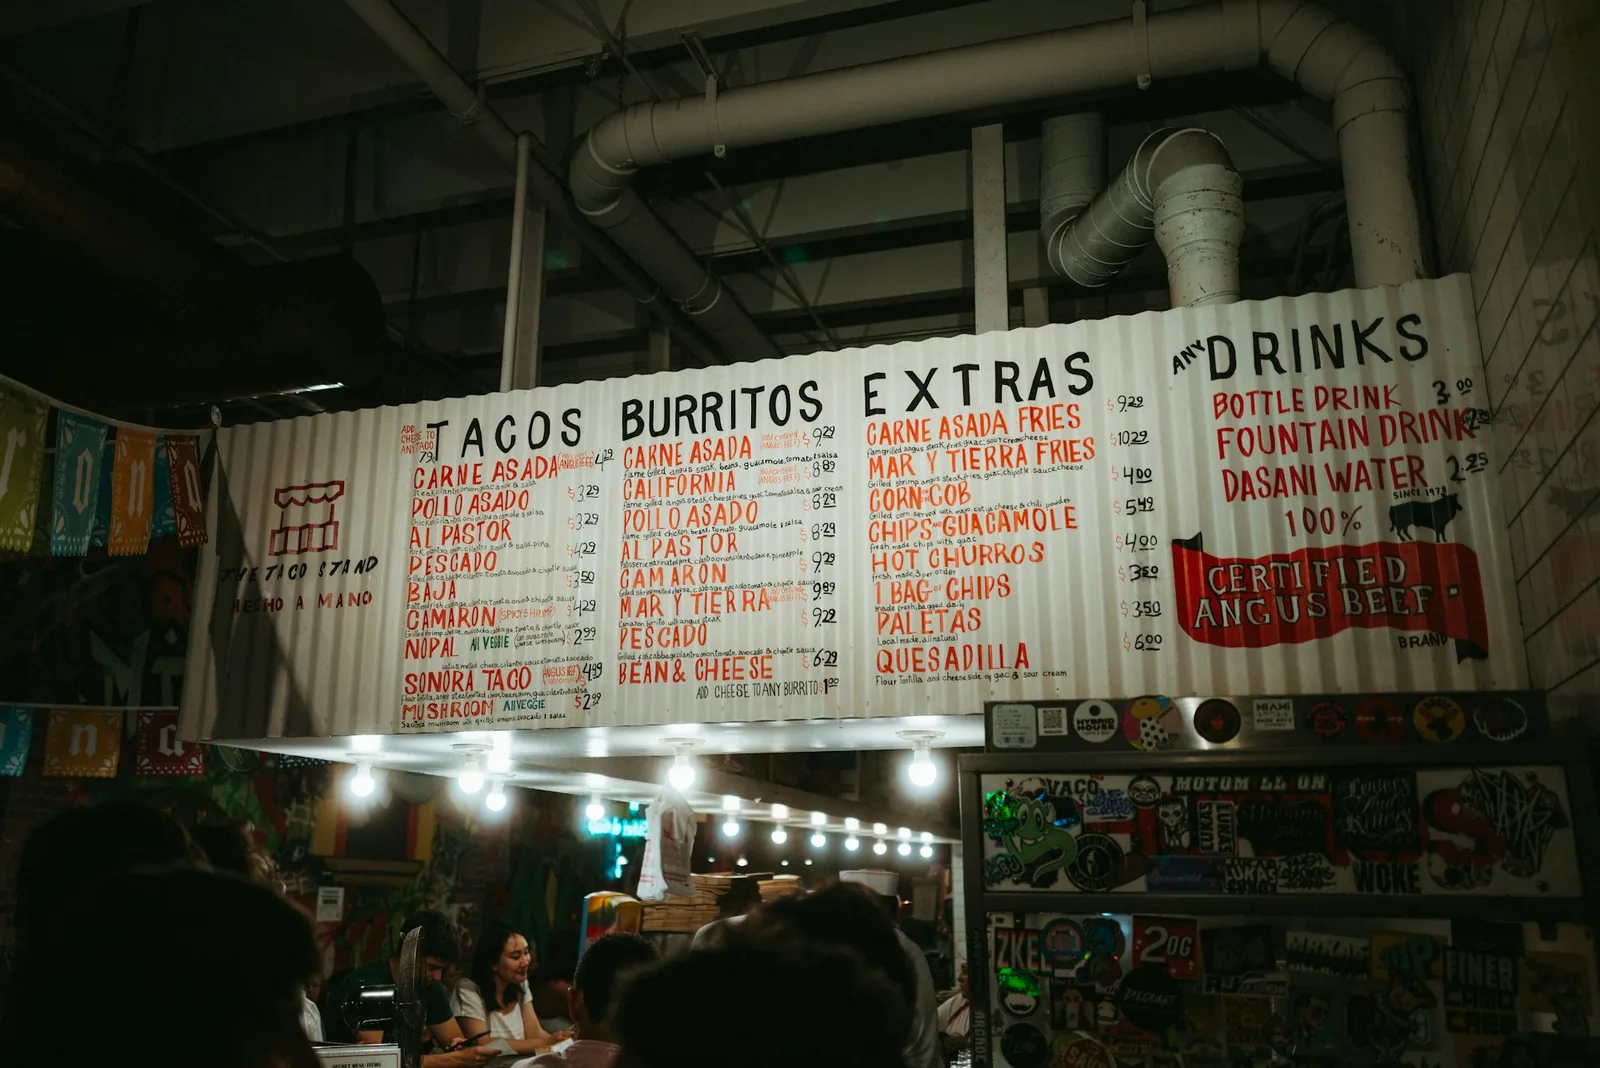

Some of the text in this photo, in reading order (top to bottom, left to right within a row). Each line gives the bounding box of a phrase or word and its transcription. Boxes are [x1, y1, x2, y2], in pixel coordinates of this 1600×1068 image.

[1172, 313, 1429, 381] ANY DRINKS
[864, 351, 1094, 418] EXTRAS
[621, 380, 823, 441] BURRITOS
[1213, 384, 1402, 420] BOTTLE DRINK
[401, 425, 415, 434] ADD
[401, 430, 435, 444] CHEESE TO
[426, 408, 581, 461] TACOS
[867, 403, 1081, 446] CARNE ASADA FRIES
[1216, 406, 1477, 460] FOUNTAIN DRINK
[401, 441, 434, 454] ANY TACO
[623, 441, 683, 470] CARNE
[689, 435, 752, 464] ASADA
[869, 436, 1095, 480] MAR Y TIERRA FRIES
[413, 462, 483, 490] CARNE
[491, 455, 558, 483] ASADA
[623, 470, 736, 501] CALIFORNIA
[1221, 454, 1429, 503] DASANI WATER
[412, 489, 529, 519] POLLO ASADO
[869, 486, 922, 512] CORN
[929, 480, 971, 507] COB
[1393, 488, 1422, 500] SINCE
[622, 500, 759, 534] POLLO ASADO
[868, 518, 932, 543] CHIPS
[942, 506, 1078, 537] GUACAMOLE
[1285, 505, 1363, 537] 100%
[410, 519, 512, 549] AL PASTOR
[621, 532, 739, 561] AL PASTOR
[220, 556, 378, 582] THE TACO STAND
[409, 550, 497, 576] PESCADO
[872, 541, 1045, 572] HOT CHURROS
[619, 563, 727, 590] CAMARON
[875, 581, 881, 605] 1
[890, 578, 933, 605] BAG
[946, 573, 1011, 601] CHIPS
[1207, 554, 1406, 596] CERTIFIED
[295, 595, 304, 611] A
[317, 590, 372, 609] MANO
[407, 579, 457, 603] BAJA
[620, 593, 664, 619] MAR
[673, 592, 682, 616] Y
[690, 587, 771, 615] TIERRA
[406, 606, 496, 631] CAMARON
[877, 607, 982, 635] PALETAS
[1193, 584, 1434, 629] ANGUS BEEF
[404, 636, 459, 660] NOPAL
[483, 635, 509, 650] VEGGIE
[619, 623, 707, 650] PESCADO
[1398, 631, 1449, 650] BRAND
[695, 655, 773, 681] CHEESE
[876, 642, 1030, 673] QUESADILLA
[404, 666, 532, 695] SONORA TACO
[696, 680, 819, 700] ADD CHEESE TO ANY BURRITO
[401, 700, 494, 721] MUSHROOM
[1076, 717, 1115, 725] HYBRID
